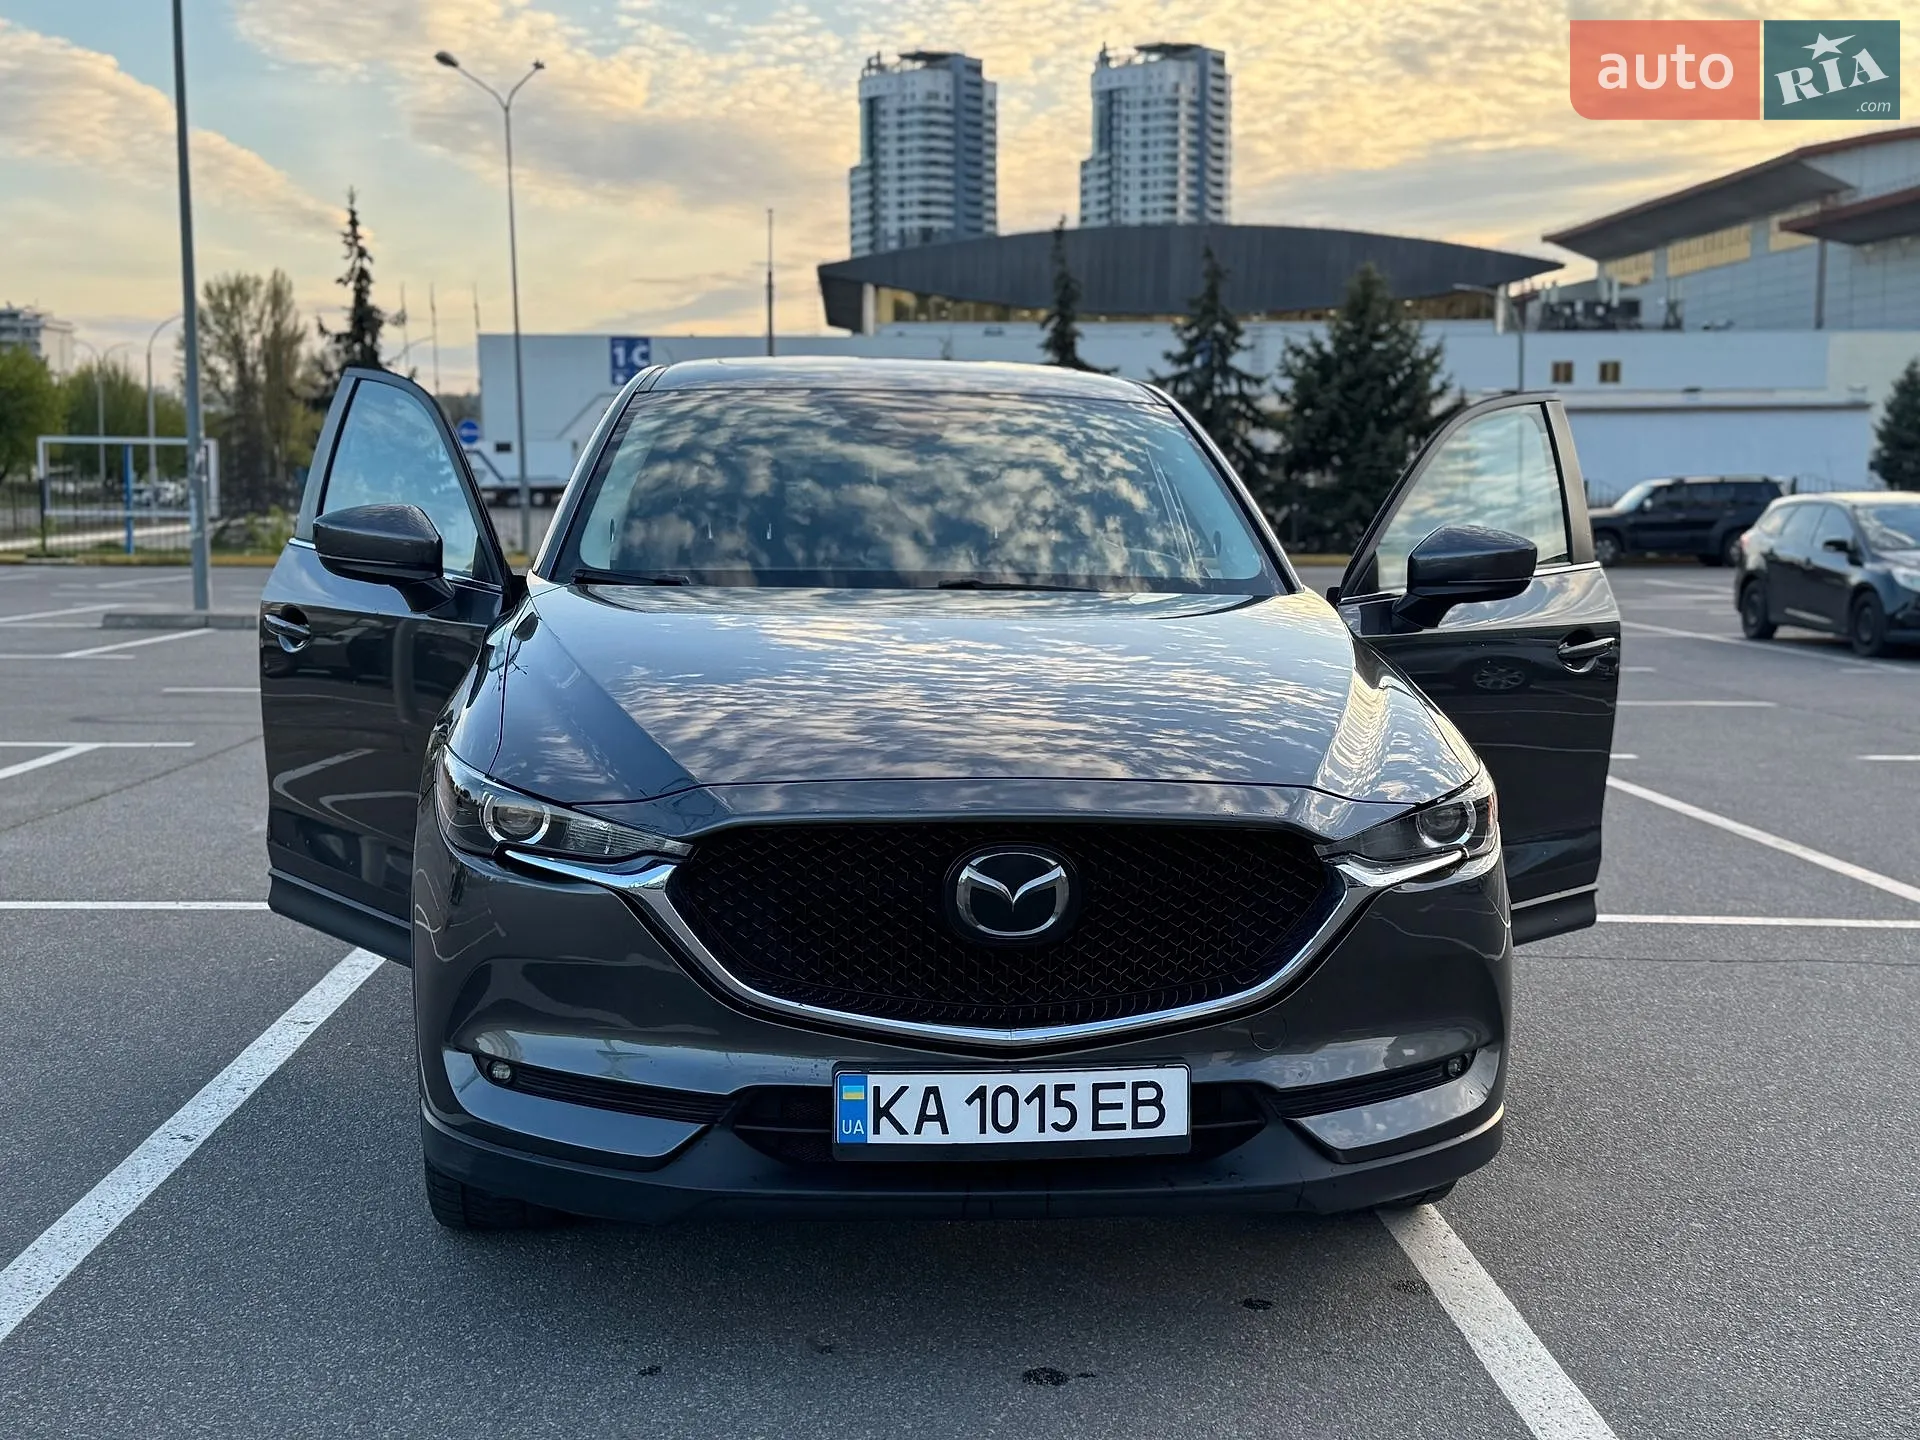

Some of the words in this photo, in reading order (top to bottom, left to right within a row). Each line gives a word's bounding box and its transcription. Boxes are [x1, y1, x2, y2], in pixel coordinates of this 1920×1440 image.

[871, 1085, 950, 1136] KA
[964, 1083, 1079, 1135] 1015
[1091, 1080, 1167, 1132] EB
[842, 1120, 865, 1135] UA
